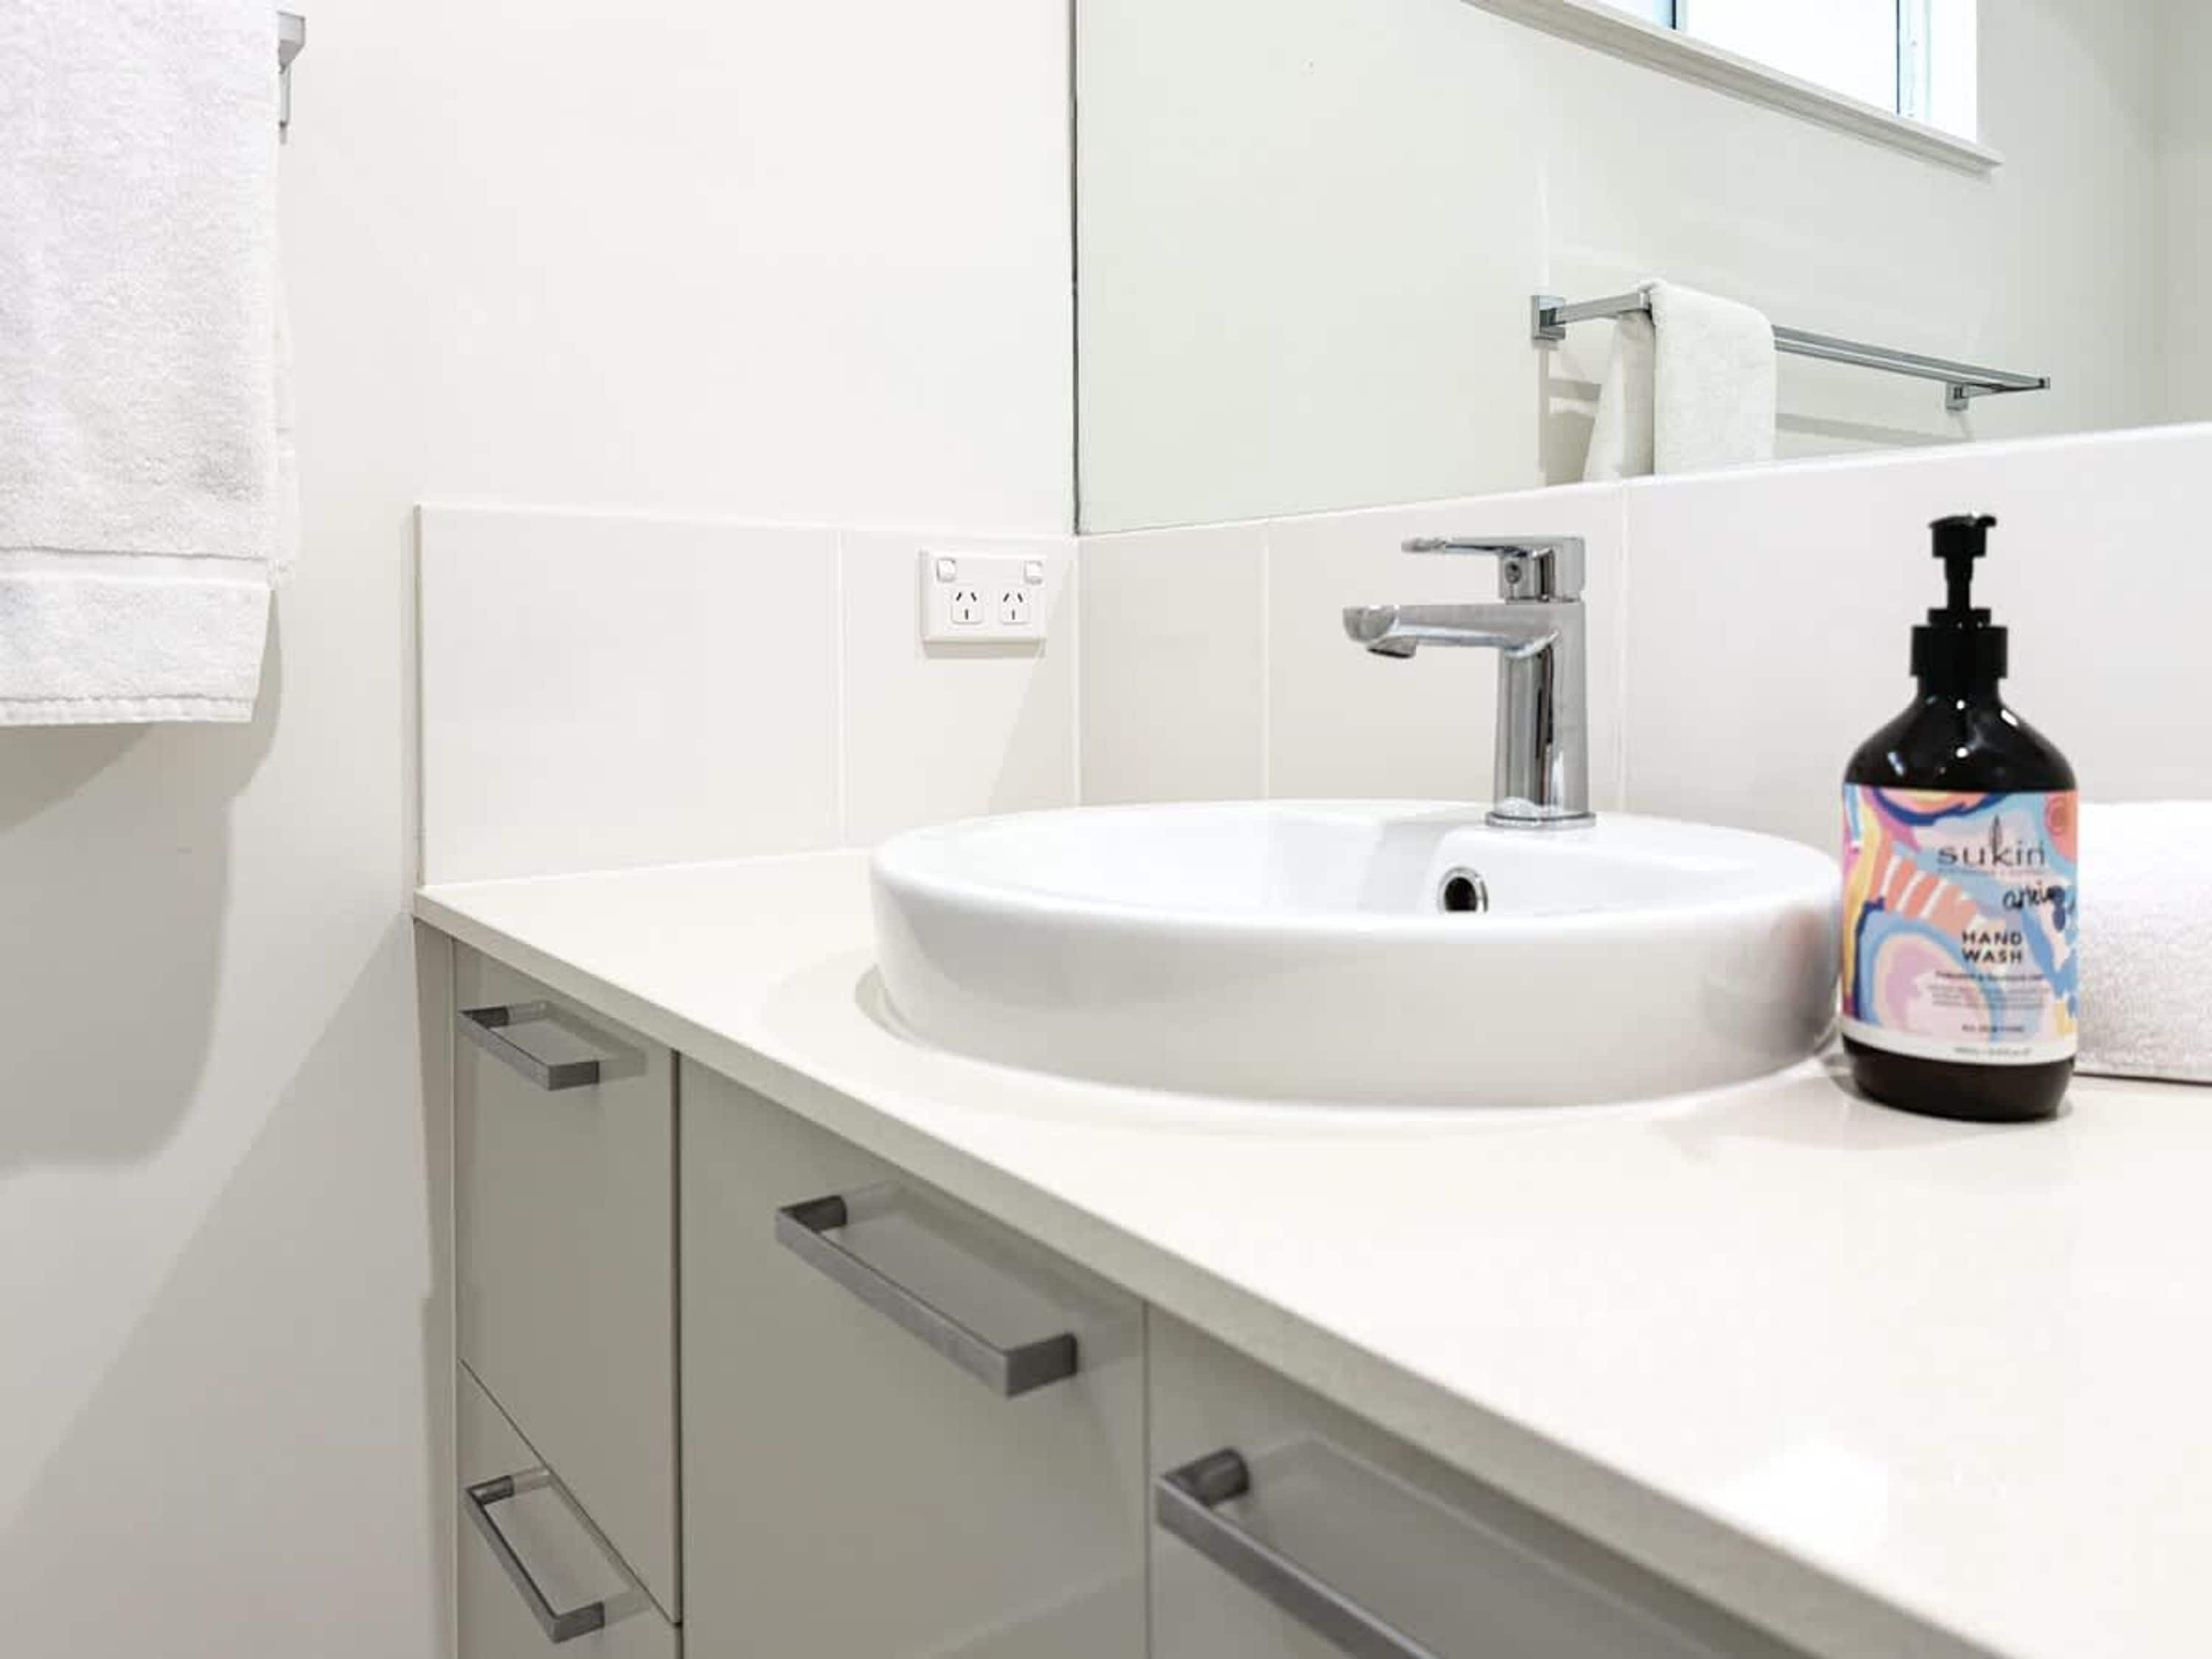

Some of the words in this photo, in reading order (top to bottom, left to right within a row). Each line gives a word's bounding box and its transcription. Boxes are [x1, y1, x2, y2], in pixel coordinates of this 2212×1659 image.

[1937, 818, 2045, 866] sukin
[1962, 931, 2022, 945] HAND
[1962, 950, 2022, 963] WASH
